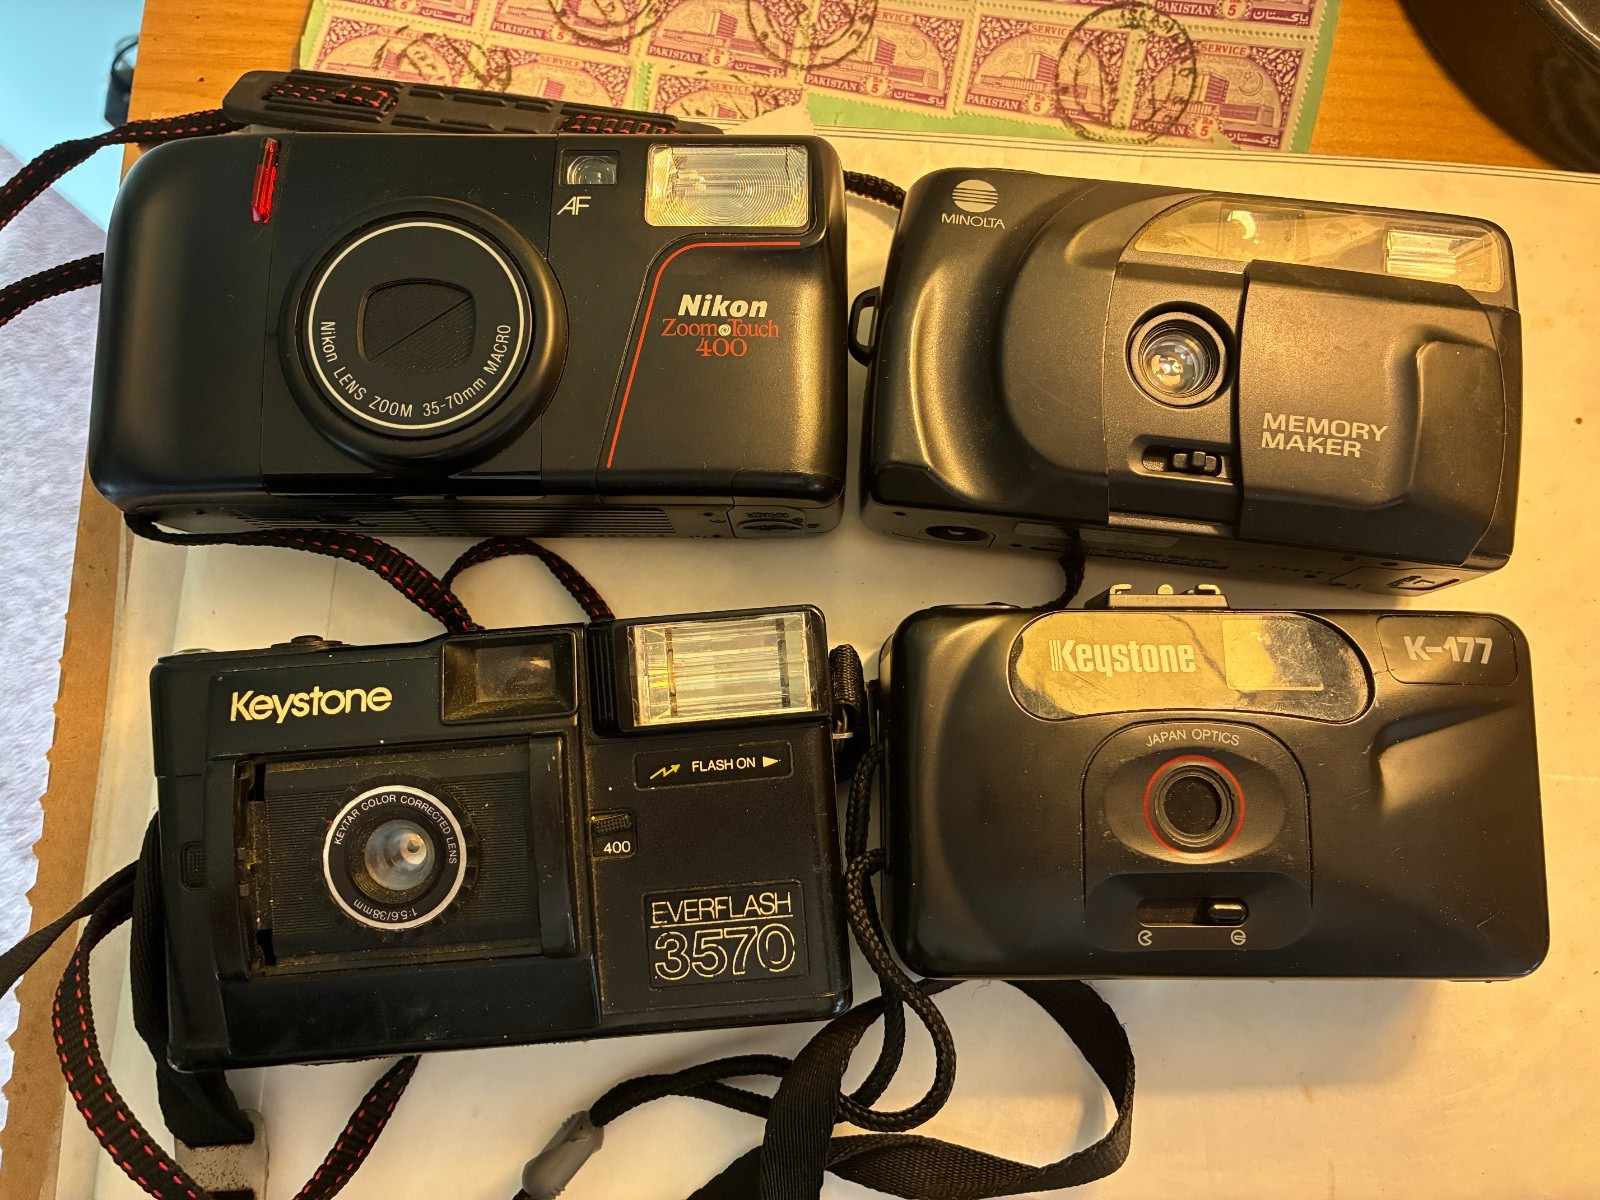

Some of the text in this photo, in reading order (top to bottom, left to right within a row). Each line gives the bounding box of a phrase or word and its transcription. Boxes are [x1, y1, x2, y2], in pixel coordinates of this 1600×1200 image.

[1156, 2, 1213, 17] PAKISTAN
[1228, 4, 1236, 17] 5
[492, 22, 543, 39] PAKISTAN
[556, 31, 564, 41] 5
[1031, 24, 1074, 37] SERVIC
[649, 46, 700, 63] PAKISTAN
[1201, 43, 1247, 56] SERVICE
[540, 55, 580, 68] SERVICE
[713, 55, 721, 65] 5
[709, 82, 750, 93] SERVICE
[805, 74, 859, 92] PAKISTAN
[871, 84, 879, 94] 5
[966, 94, 1019, 111] PAKISTAN
[1033, 102, 1041, 112] 5
[1200, 126, 1209, 137] 5
[557, 196, 592, 216] AF
[941, 213, 1006, 230] MINOLTA
[677, 294, 768, 318] Nikon
[661, 318, 780, 339] Zoom Touch
[695, 337, 748, 357] 400
[320, 321, 512, 418] Nikon LENS ZOOM 35-70mm MACRO
[1262, 412, 1389, 442] MEMORY
[1261, 431, 1362, 458] MAKER
[1049, 640, 1197, 677] Keystone
[1403, 635, 1493, 665] K-177
[230, 686, 393, 724] Keystone
[1145, 728, 1240, 747] JAPAN OPTICS
[692, 757, 756, 772] FLASH ON
[333, 794, 458, 864] KEYTAR COLOR CORRECTED LENS
[603, 840, 631, 854] 400
[651, 891, 793, 925] EVERFLASH
[655, 923, 796, 981] 3570
